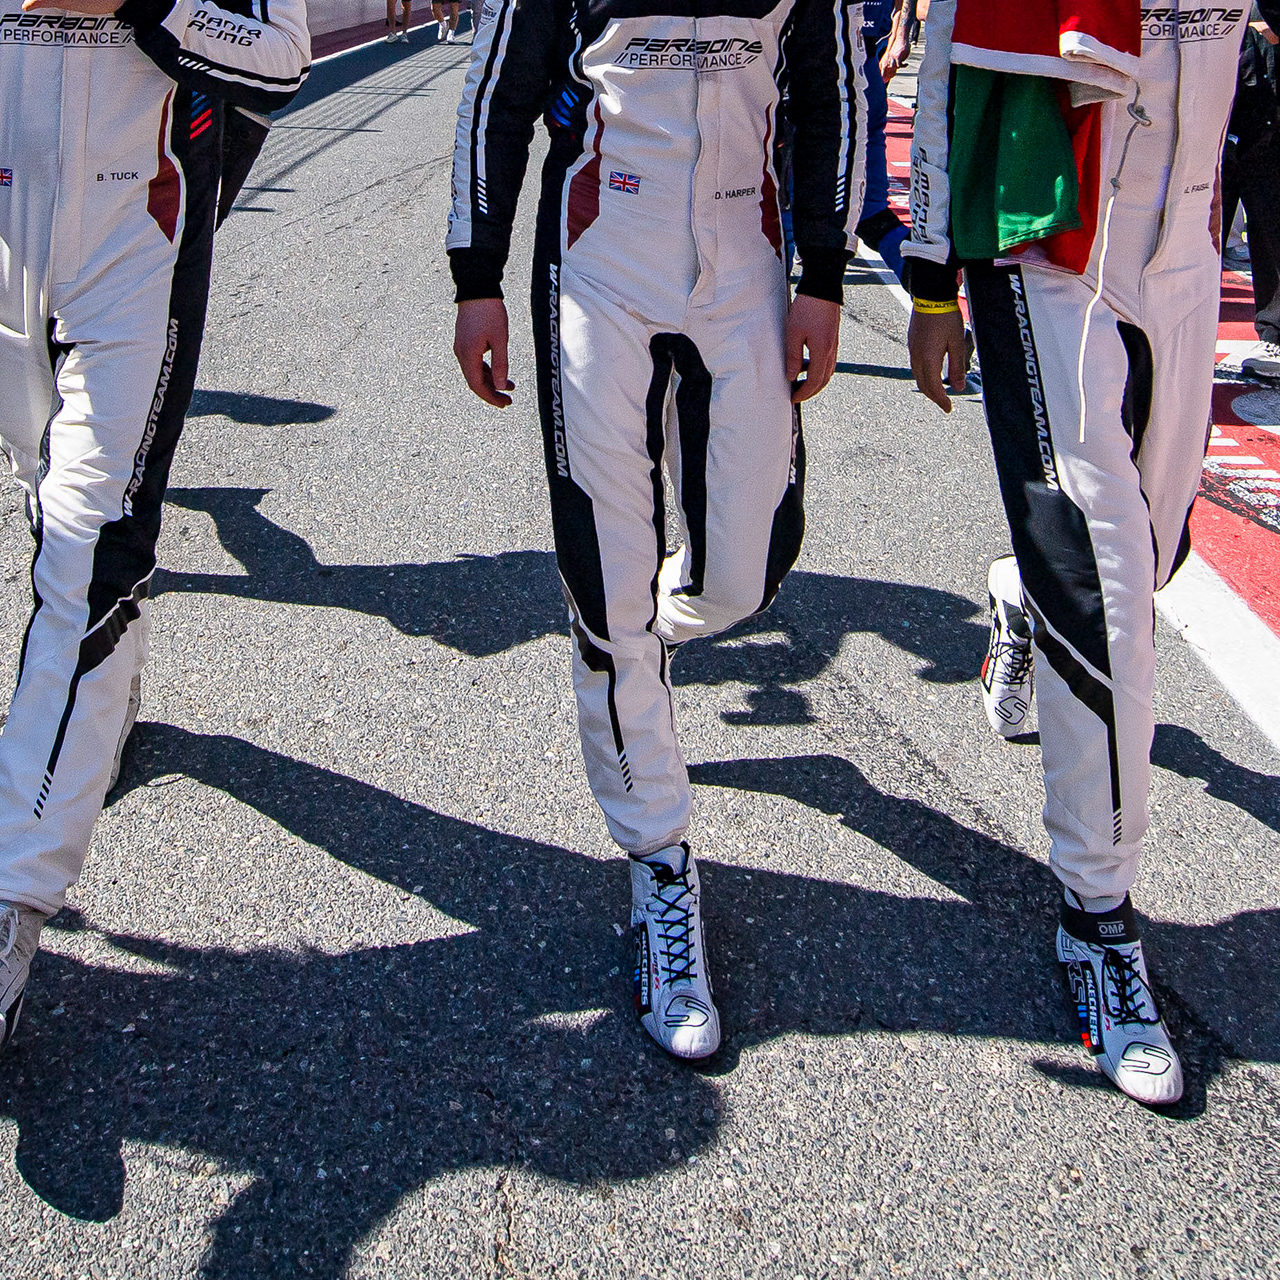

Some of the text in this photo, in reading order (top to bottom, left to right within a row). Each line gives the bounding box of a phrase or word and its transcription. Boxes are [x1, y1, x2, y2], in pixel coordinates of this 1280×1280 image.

[96, 171, 139, 181] B. TUCK
[714, 187, 756, 200] D. HARPER
[549, 263, 569, 477] W-RACINGTEAM.COM
[1008, 273, 1059, 491] W-RACINGTEAM.COM
[122, 318, 178, 517] W-RACINGTEAM.COM
[1099, 923, 1125, 934] OMP
[641, 931, 649, 1006] SKECHERS
[1084, 969, 1100, 1046] SKECHERS
